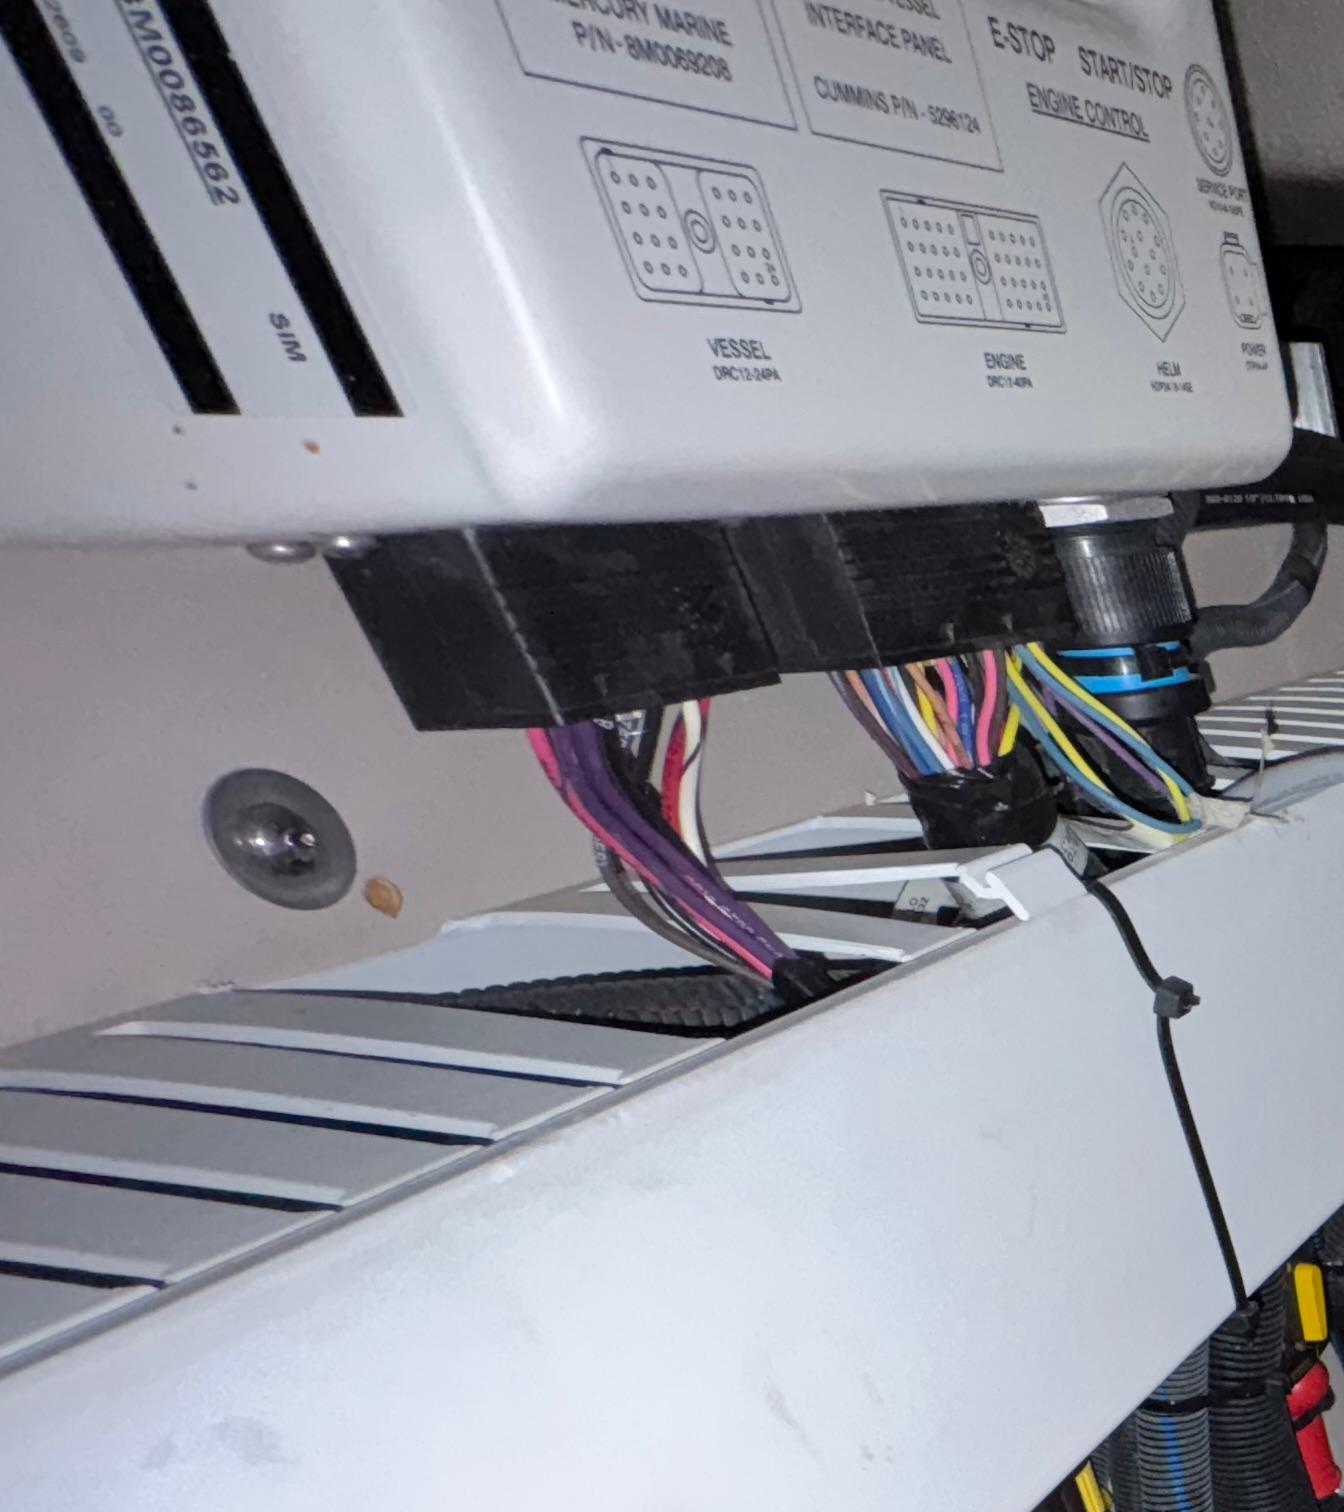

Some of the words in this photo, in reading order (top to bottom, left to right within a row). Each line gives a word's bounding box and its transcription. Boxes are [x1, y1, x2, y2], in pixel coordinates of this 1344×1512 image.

[571, 20, 615, 53] P/N
[654, 4, 733, 46] MARINE
[805, 2, 900, 49] INTERFACE
[901, 28, 952, 64] PANEL
[988, 16, 1055, 63] E-STOP
[1078, 46, 1172, 99] START/STOP
[122, 0, 240, 204] M0086562
[814, 75, 889, 114] CUMMINS
[890, 94, 918, 121] P/N
[1026, 82, 1083, 120] ENGINE
[1085, 101, 1149, 137] CONTROL
[269, 312, 307, 361] SIM
[707, 338, 771, 360] VESSEL
[1241, 342, 1266, 357] POWER
[984, 352, 1027, 371] ENGINE
[1157, 361, 1182, 377] HELM
